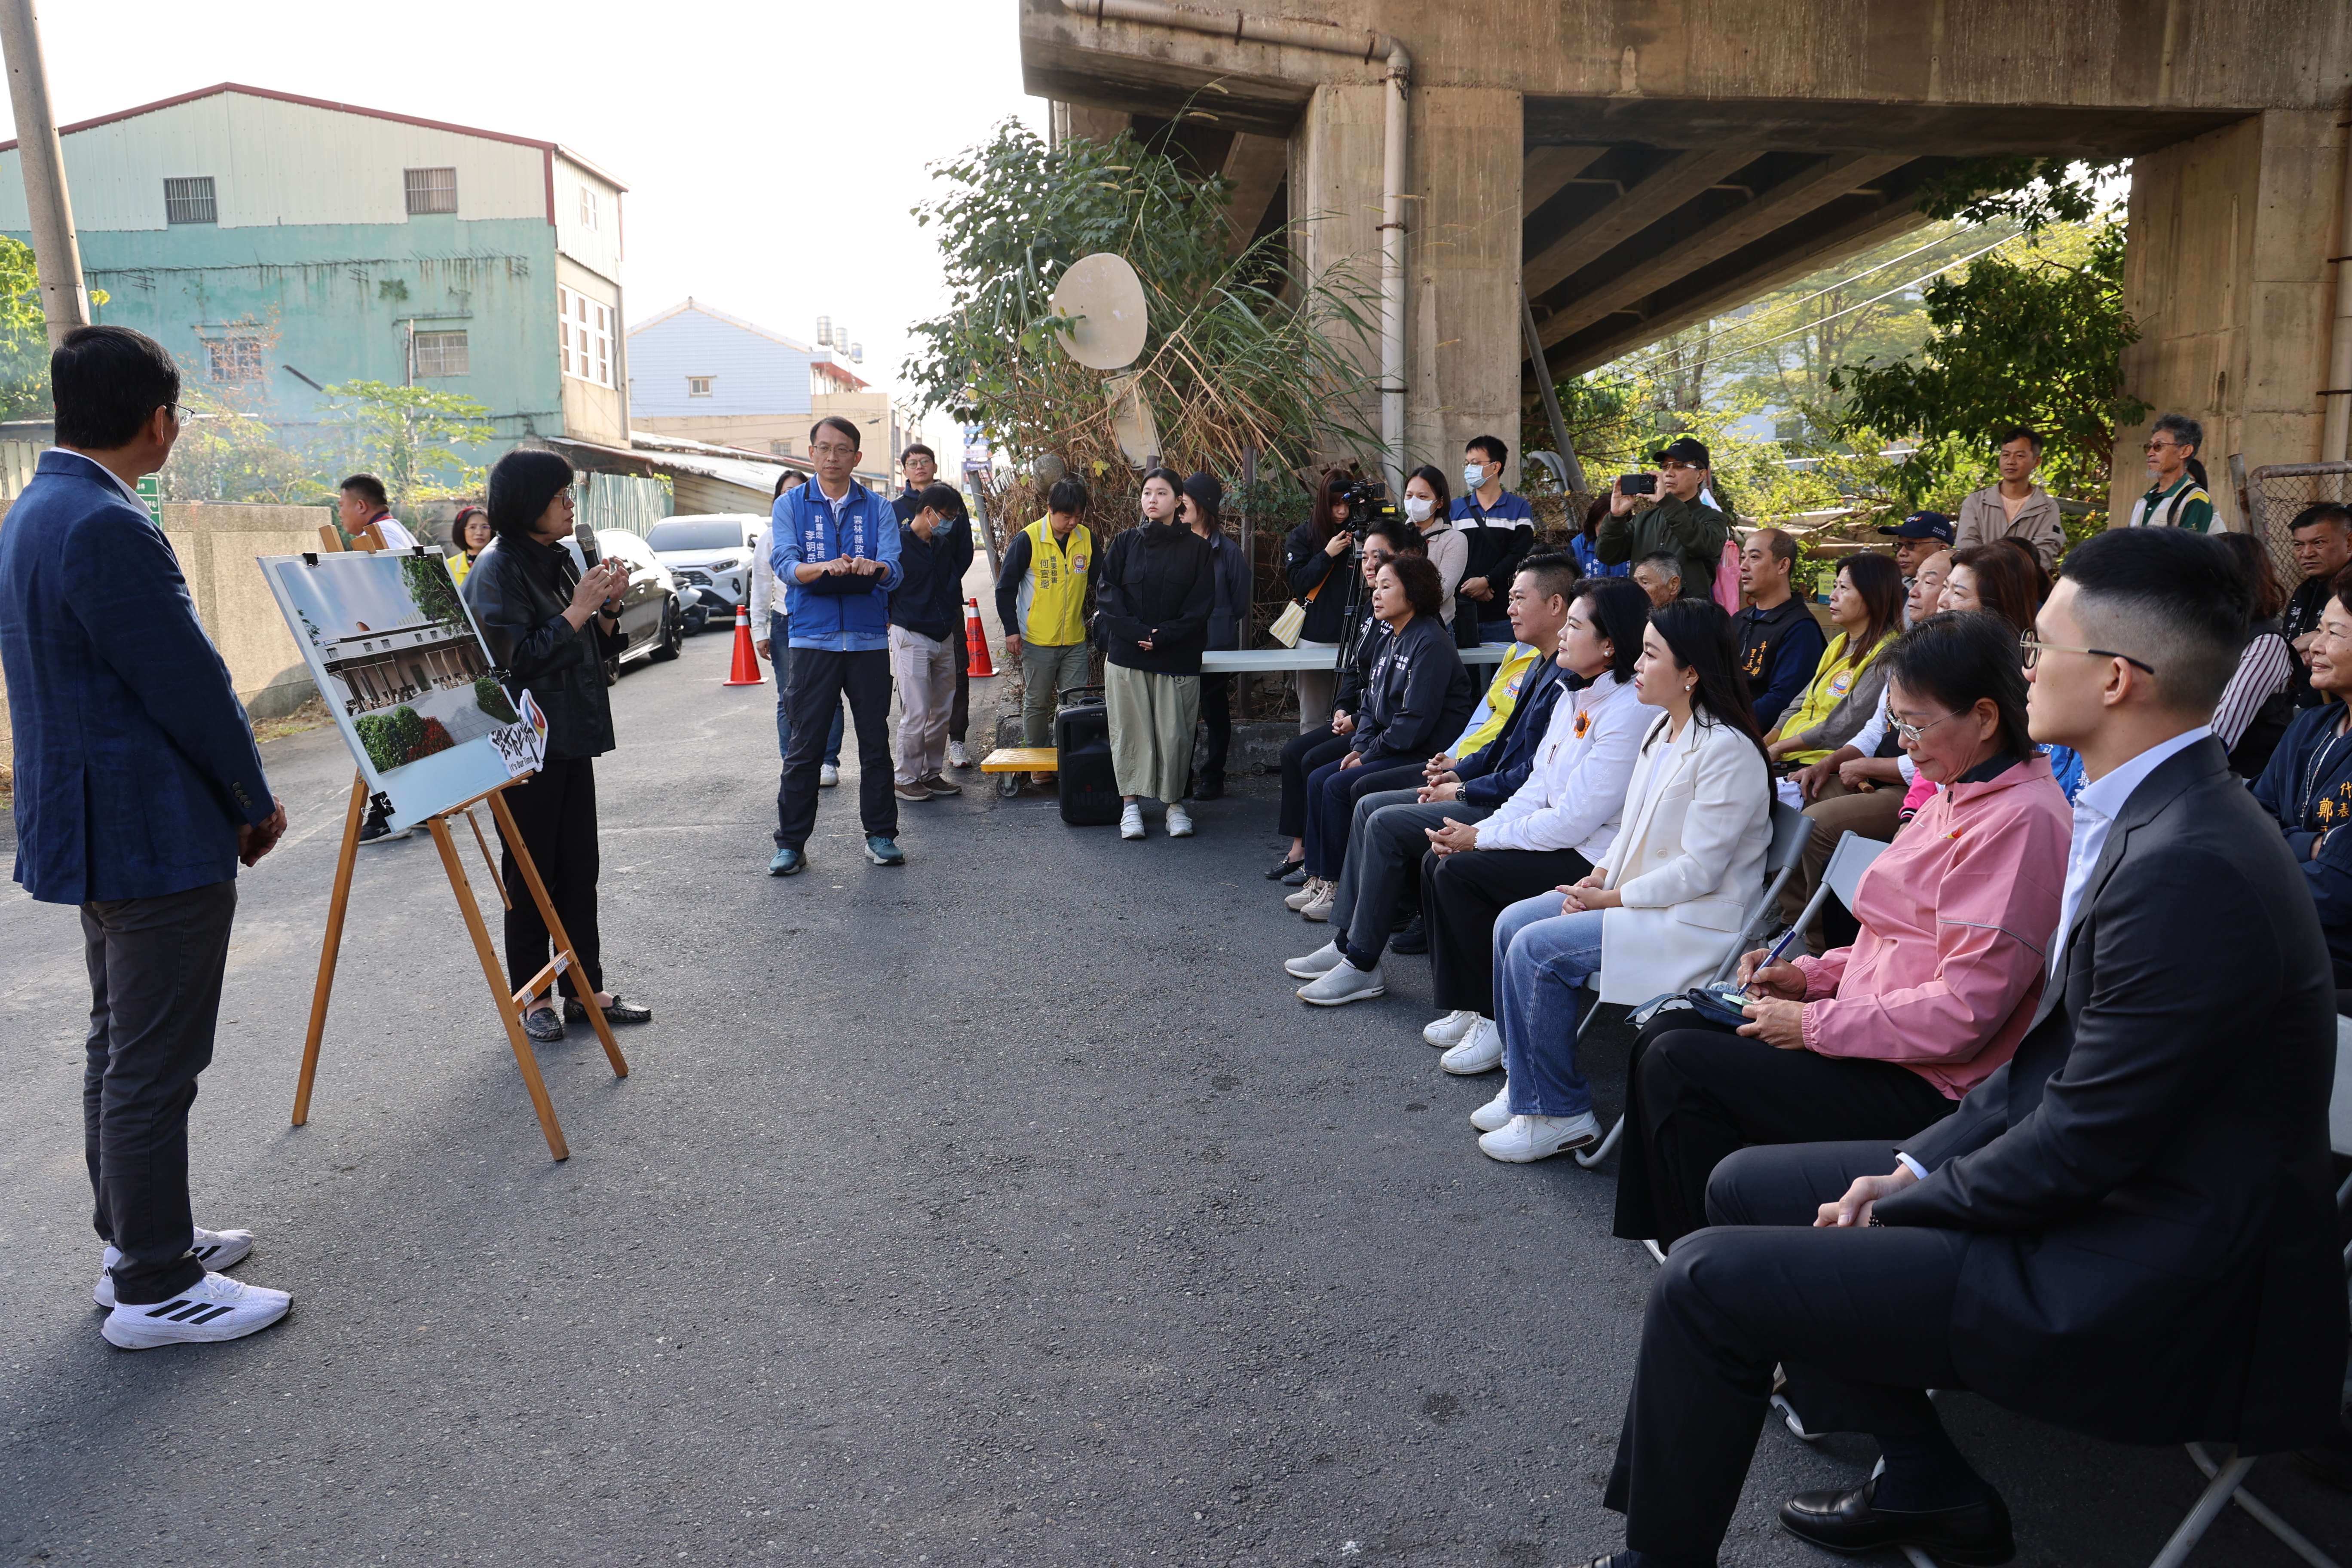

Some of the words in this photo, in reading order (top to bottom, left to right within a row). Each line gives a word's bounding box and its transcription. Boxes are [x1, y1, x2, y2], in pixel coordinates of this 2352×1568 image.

[805, 530, 816, 563] 李明岳
[509, 763, 518, 772] It's
[523, 756, 534, 765] Time
